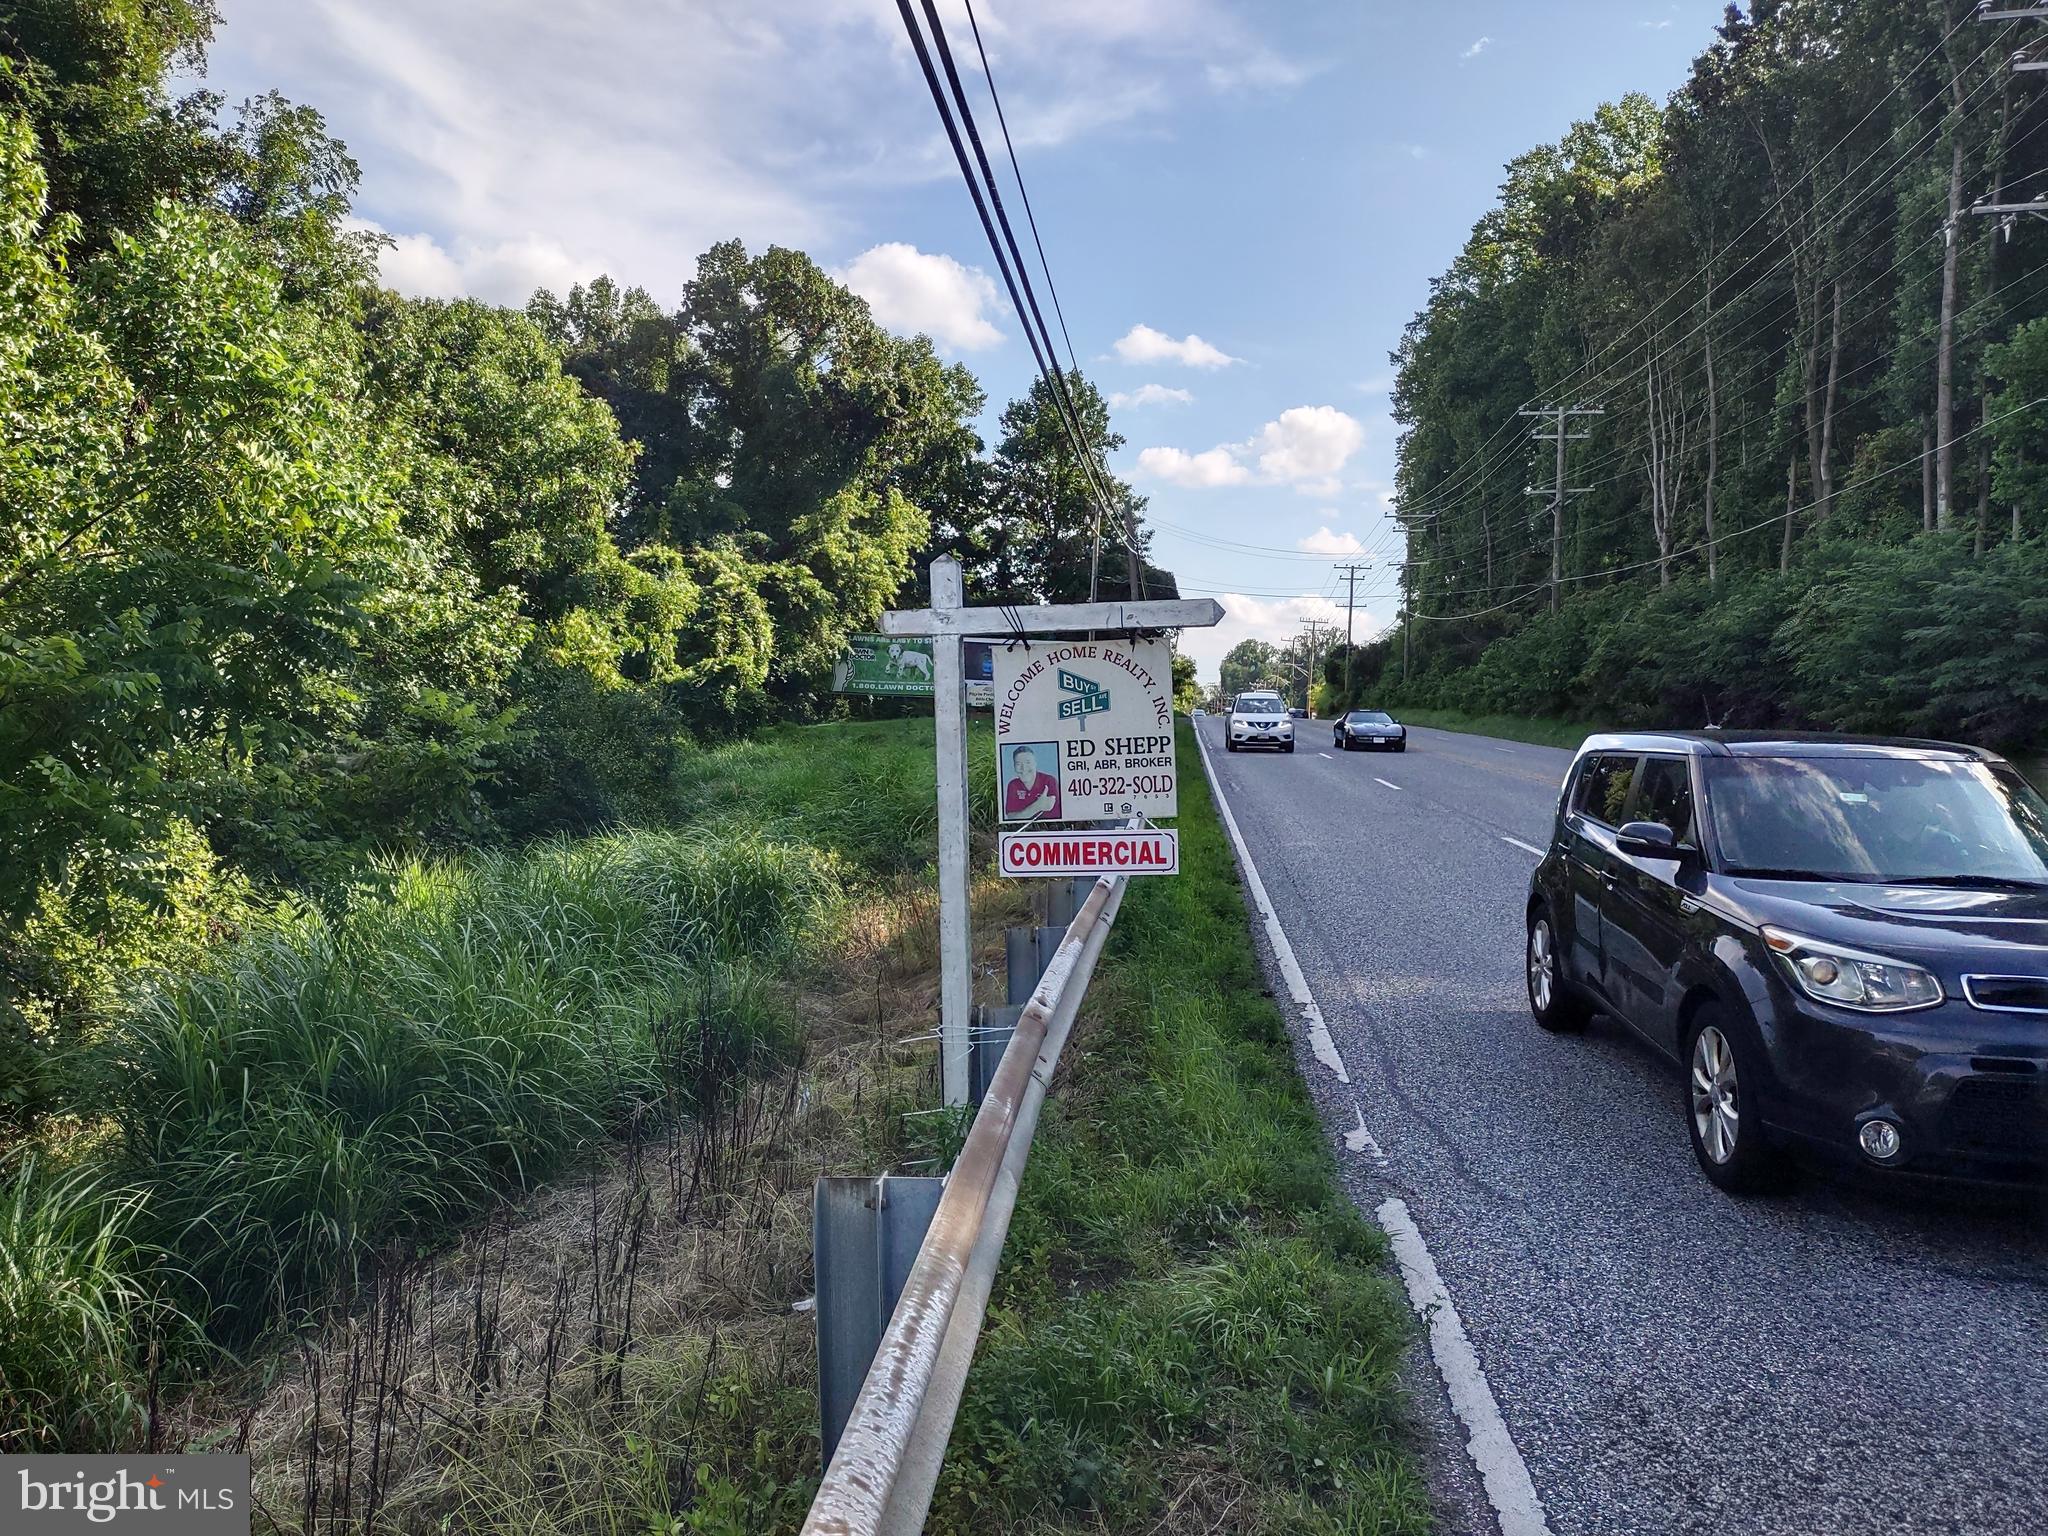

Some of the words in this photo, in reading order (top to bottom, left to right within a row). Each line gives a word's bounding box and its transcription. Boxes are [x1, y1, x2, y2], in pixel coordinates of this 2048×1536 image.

[848, 634, 875, 642] LAWNS
[998, 661, 1044, 735] WELCOME
[1047, 646, 1097, 665] HOME
[1152, 695, 1171, 729] INC.
[1063, 673, 1091, 693] BUY
[1062, 696, 1103, 717] SELL
[1066, 739, 1096, 757] ED
[1104, 736, 1171, 756] SHEPP
[1067, 761, 1090, 772] GRI,
[1094, 759, 1121, 770] ABR,
[1125, 757, 1172, 768] BROKER
[1068, 774, 1173, 797] 410-322-SOLD
[1009, 841, 1167, 866] COMMERCIAL
